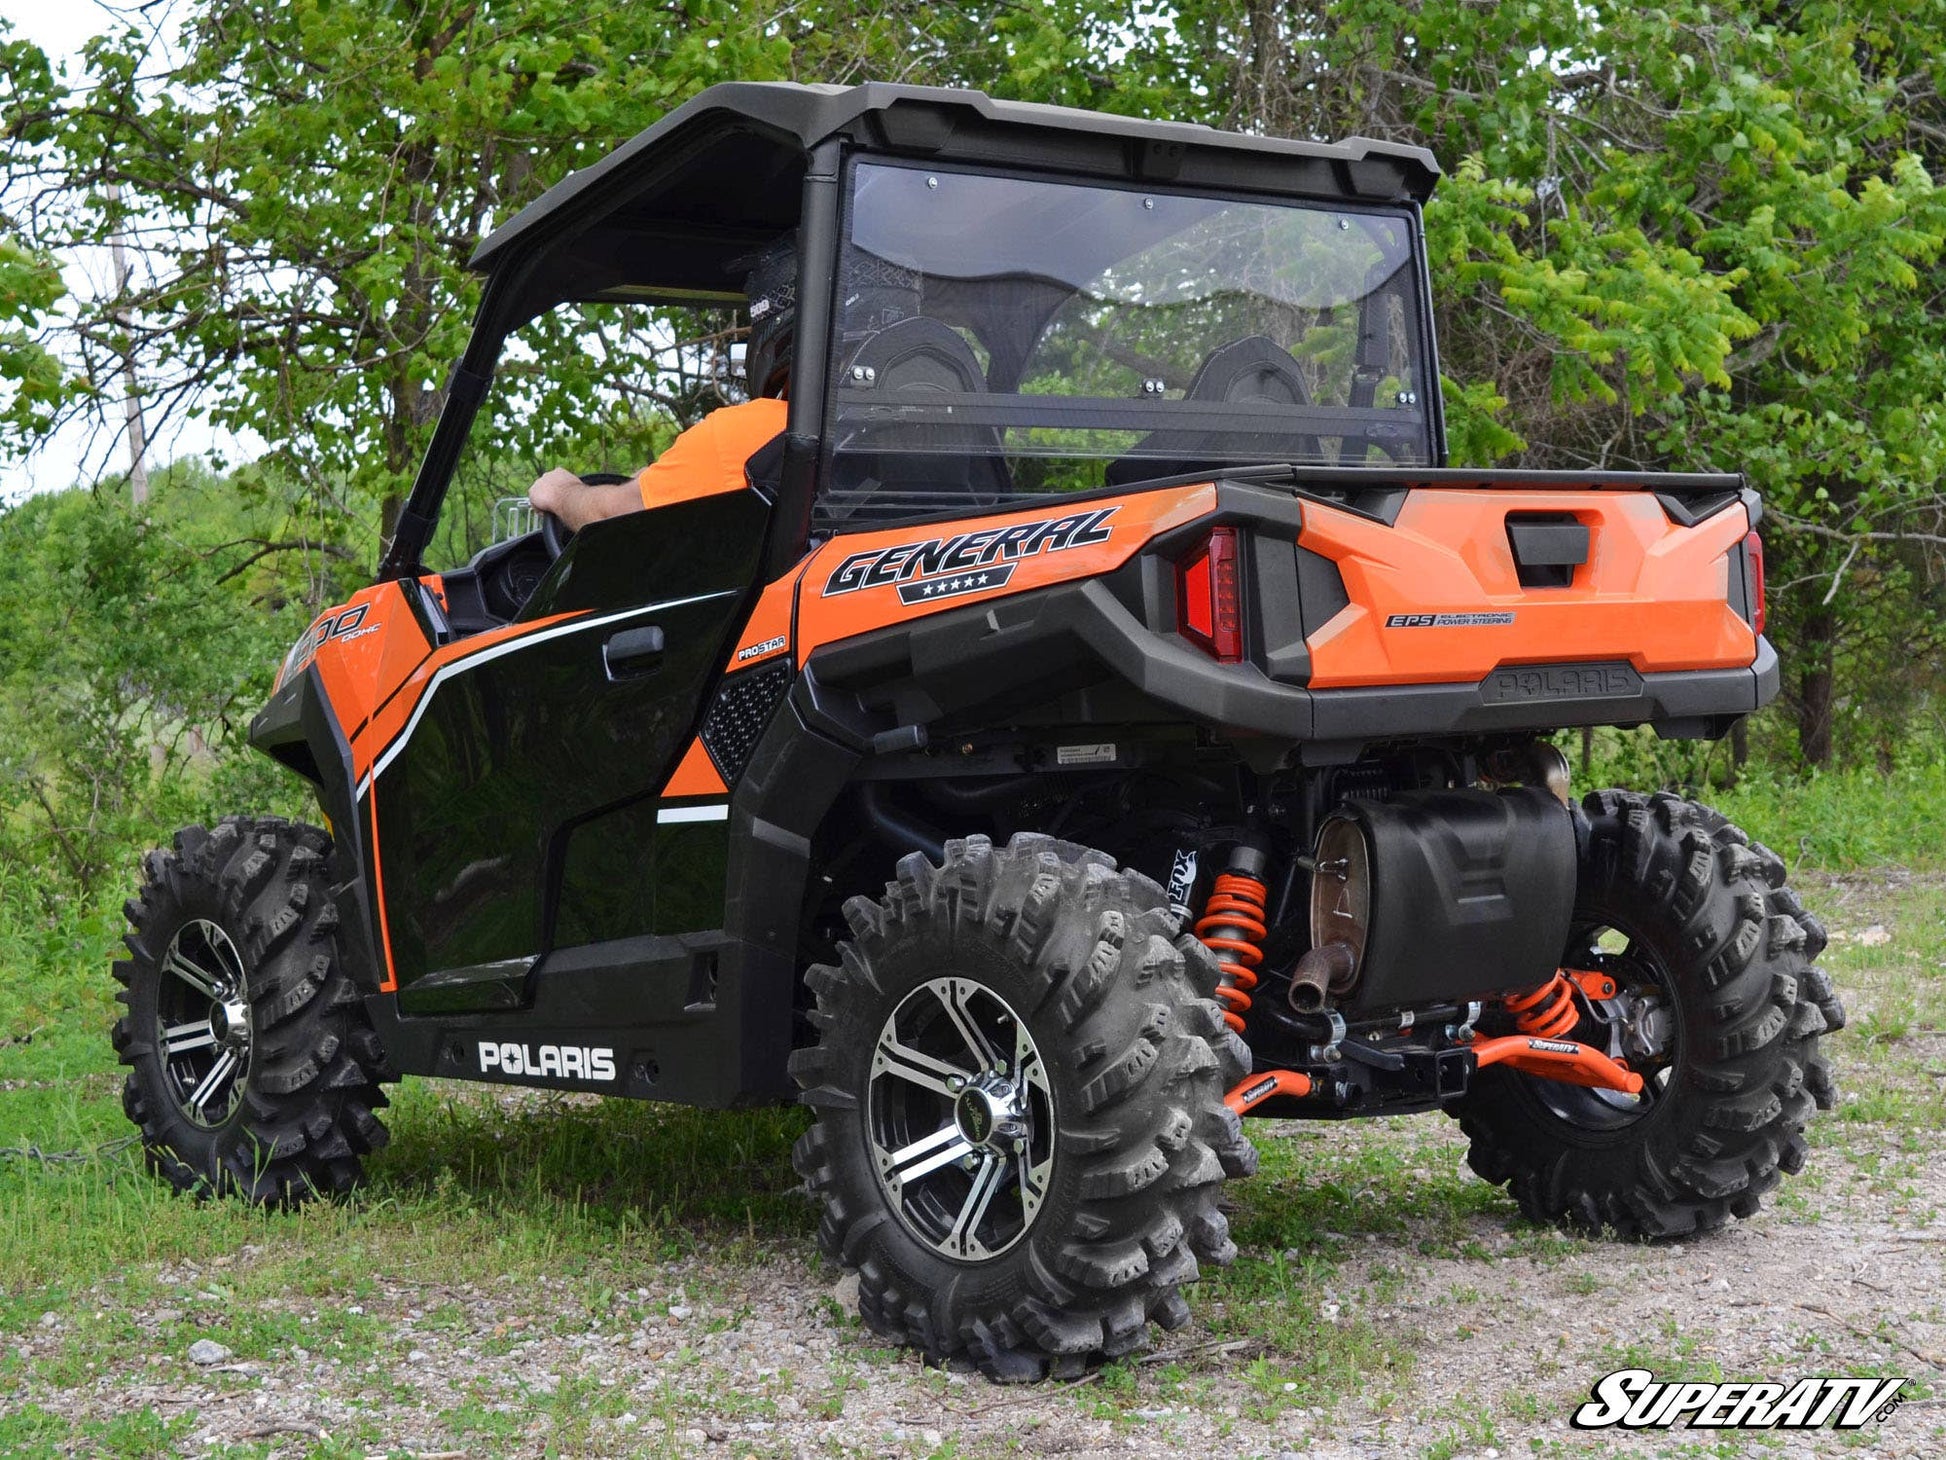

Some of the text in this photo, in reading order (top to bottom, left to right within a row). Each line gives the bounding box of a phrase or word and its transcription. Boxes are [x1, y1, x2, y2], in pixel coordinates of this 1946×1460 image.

[821, 505, 1124, 598] GENERAL
[1390, 615, 1434, 627] EPS
[1471, 617, 1513, 625] STEERING
[738, 635, 785, 661] PROSTAR
[1496, 668, 1631, 698] POLARIS
[1167, 849, 1196, 900] FOX
[478, 1041, 616, 1081] POLARIS
